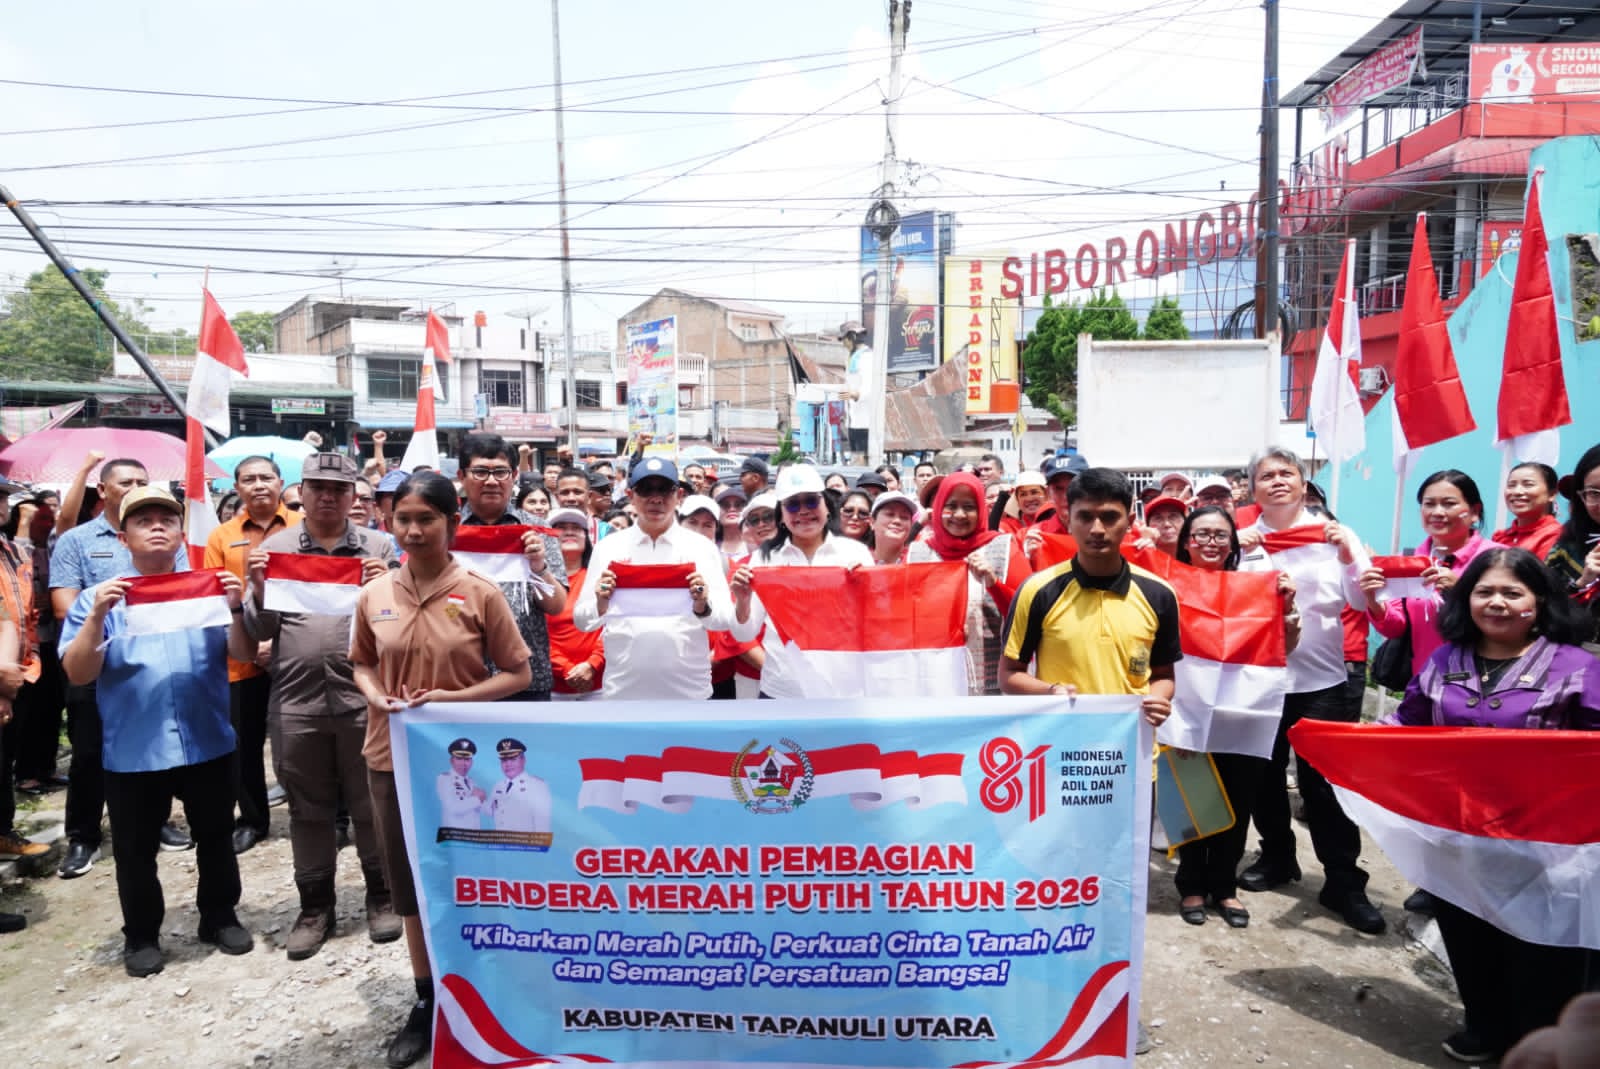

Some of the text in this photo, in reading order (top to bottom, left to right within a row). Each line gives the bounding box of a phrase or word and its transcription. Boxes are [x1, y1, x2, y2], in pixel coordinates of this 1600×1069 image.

[1551, 63, 1600, 75] RECOM
[1055, 457, 1071, 468] UT
[1061, 750, 1124, 761] INDONESIA
[979, 737, 1053, 823] 81
[1061, 764, 1127, 776] BERDAULAT
[1061, 779, 1114, 791] ADIL DAN
[1061, 793, 1113, 806] MAKMUR
[575, 843, 974, 875] GERAKAN PEMBAGIAN
[456, 876, 1100, 911] BENDERA MERAH PUTIH TAHUN 2026
[463, 925, 1094, 957] "Kibarkan Merah Putih, Perkuat Cinta Tanah Air
[554, 959, 1010, 989] dan Semangat Persatuan Bangsa!
[563, 1008, 995, 1038] KABUPATEN TAPANULI UTARA
